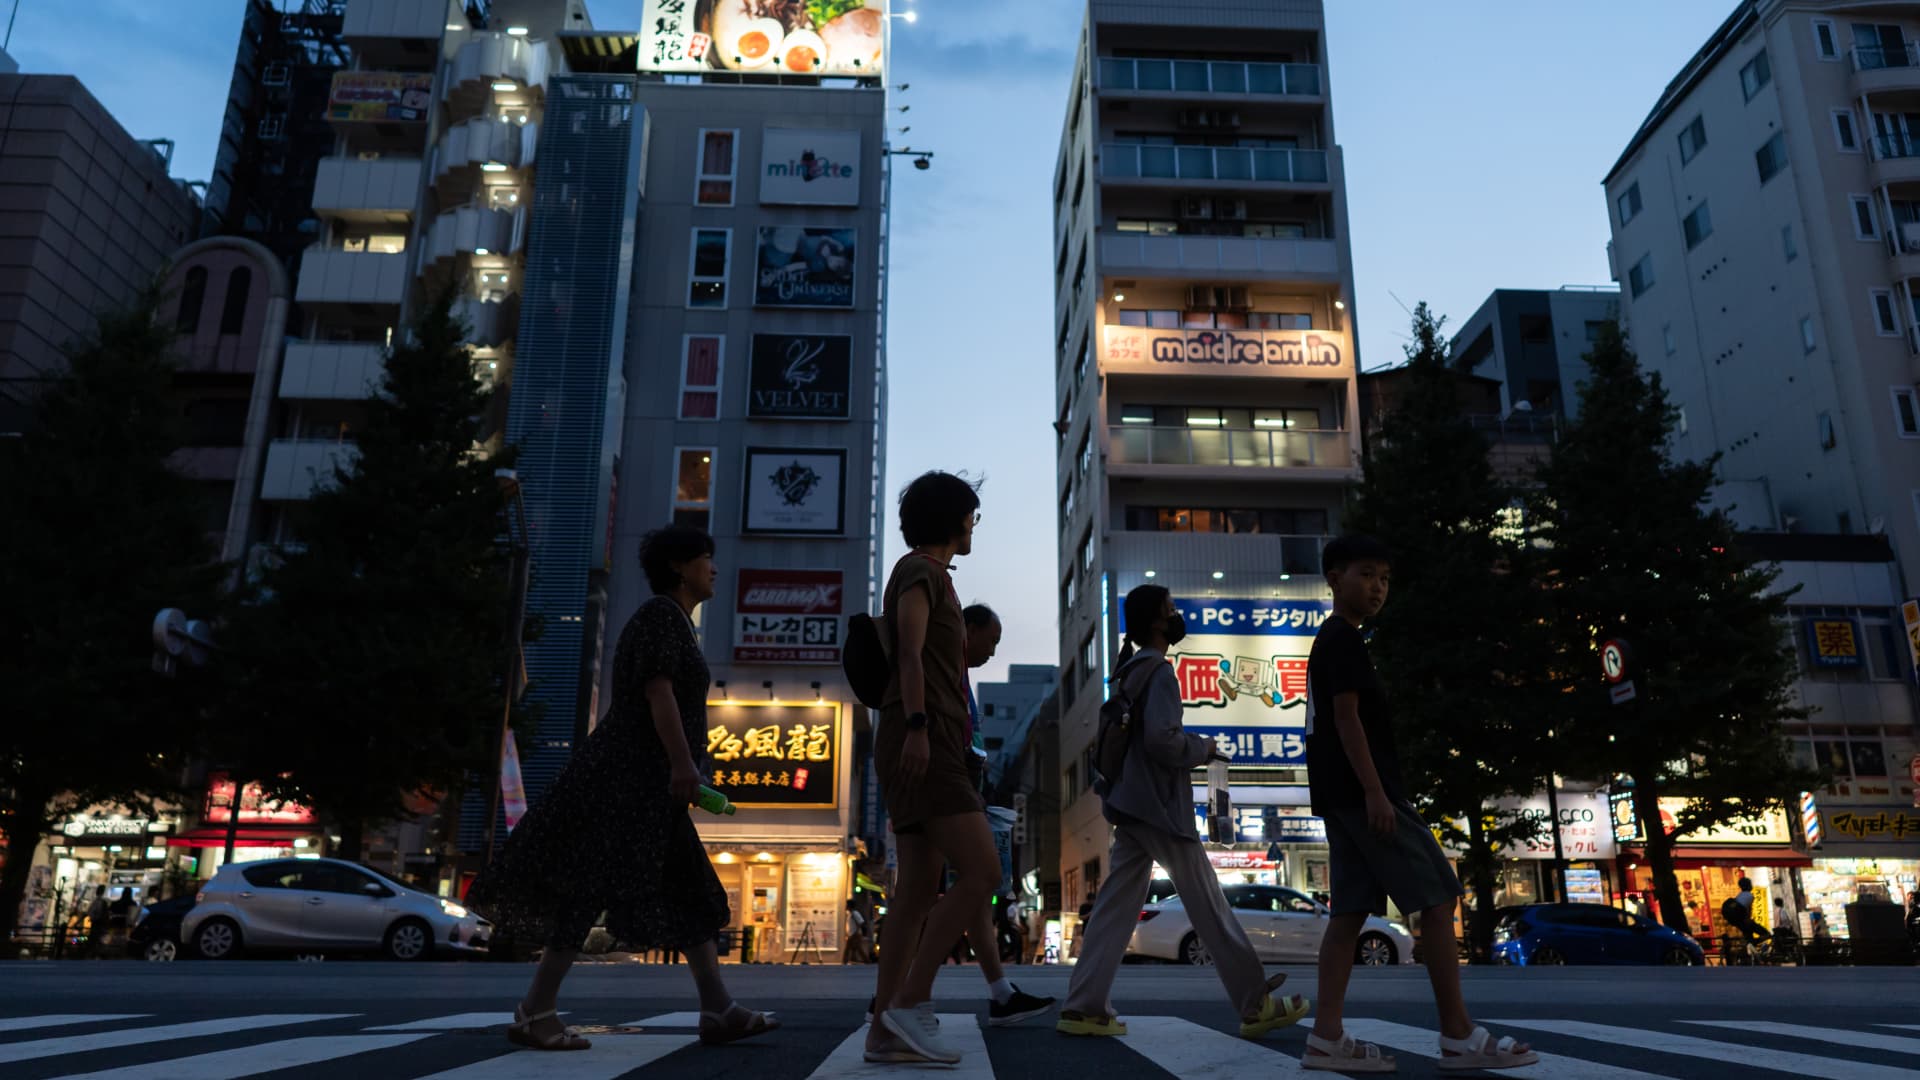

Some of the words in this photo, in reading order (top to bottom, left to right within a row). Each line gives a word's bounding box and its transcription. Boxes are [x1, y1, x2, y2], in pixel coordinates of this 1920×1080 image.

[767, 159, 853, 178] minette
[1109, 335, 1142, 347] メイド
[1152, 332, 1341, 366] maidreamin
[1109, 348, 1141, 359] カフェ
[753, 390, 844, 409] VELVET
[742, 616, 801, 632] トレカ
[805, 620, 836, 643] 3F
[1819, 623, 1854, 655] 薬
[1511, 808, 1594, 823] TOBCCO
